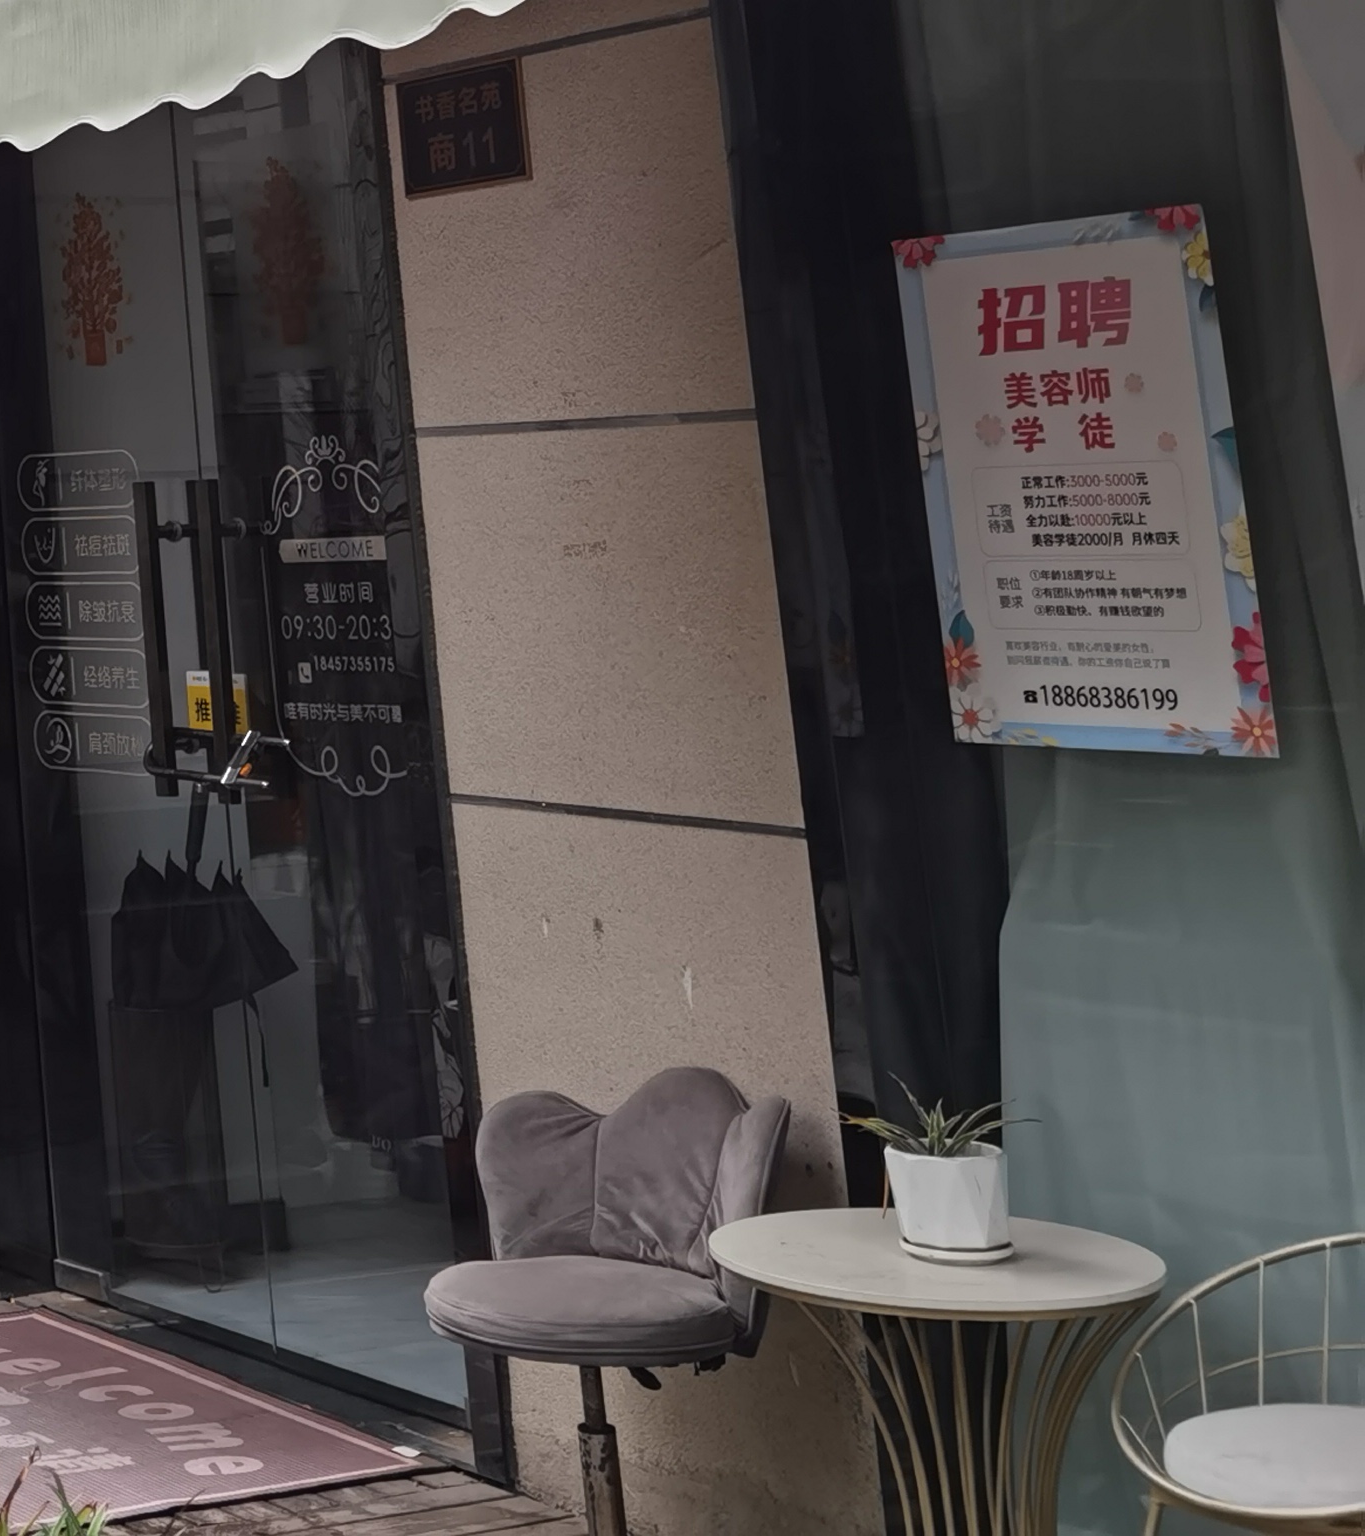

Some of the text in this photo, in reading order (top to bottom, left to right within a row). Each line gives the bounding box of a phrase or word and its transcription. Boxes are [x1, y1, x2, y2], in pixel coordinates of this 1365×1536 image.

[415, 81, 502, 124] 书香名苑
[977, 276, 1132, 356] 招聘
[1004, 367, 1111, 409] 美容师
[987, 504, 1012, 518] 工资
[988, 519, 1015, 534] 待遇
[295, 539, 374, 559] WELCOME
[304, 581, 374, 604] 营业时间
[78, 600, 136, 624] 除皱抗衰
[313, 655, 395, 673] 18457355175
[83, 666, 140, 690] 经络养生
[195, 697, 211, 722] 推
[1040, 684, 1179, 711] 18868386199
